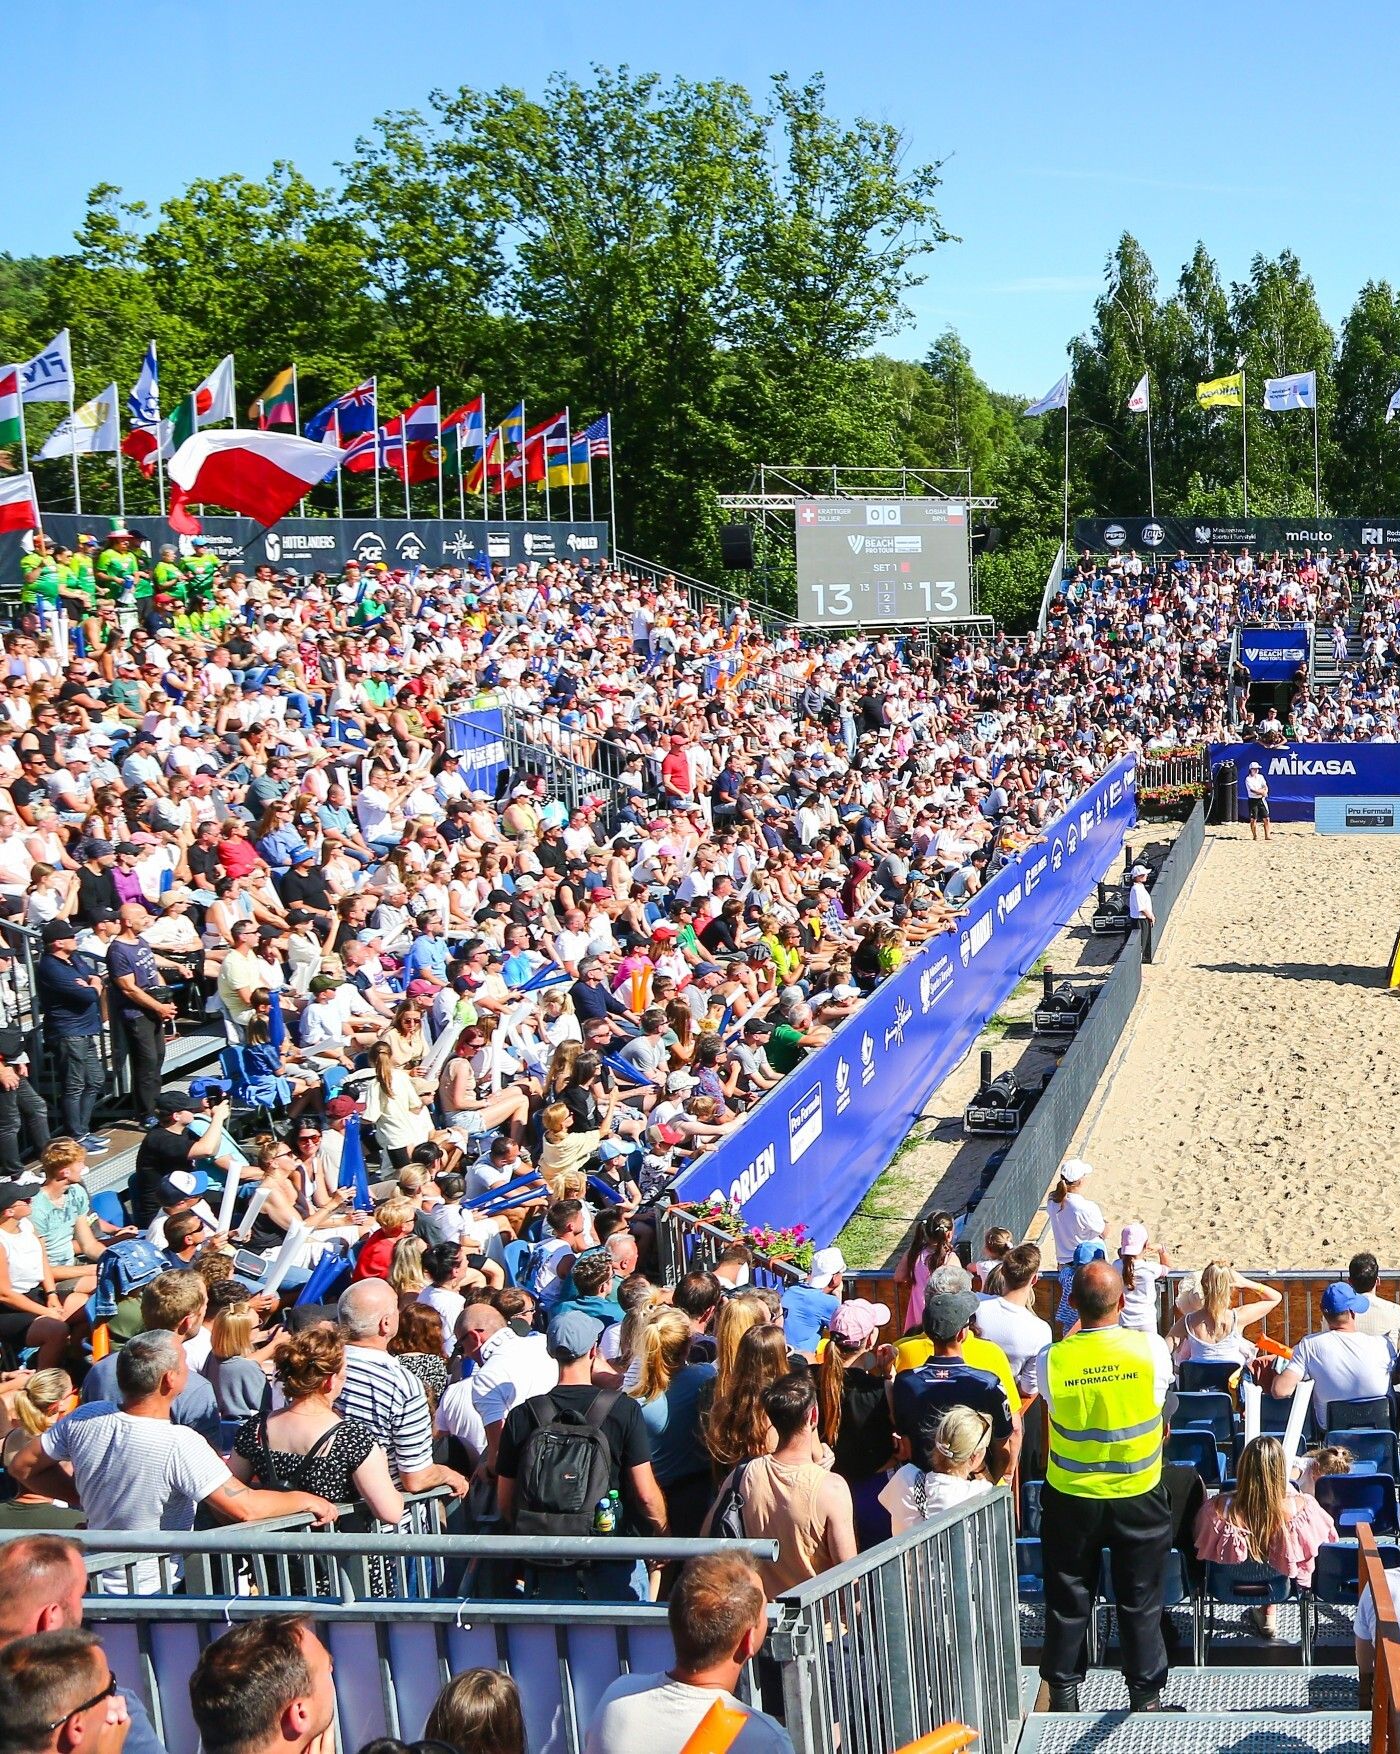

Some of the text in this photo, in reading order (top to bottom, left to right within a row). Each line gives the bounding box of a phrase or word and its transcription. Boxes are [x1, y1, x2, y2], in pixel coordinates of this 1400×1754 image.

[871, 509, 897, 521] 0 0
[1286, 530, 1333, 542] mAuto
[865, 538, 893, 547] BEACH
[358, 546, 382, 561] PGE
[873, 563, 891, 572] SET
[859, 583, 870, 591] 13
[903, 582, 913, 591] 13
[811, 583, 853, 615] 13
[883, 594, 890, 602] 2
[919, 581, 958, 612] 13
[883, 605, 890, 613] 3
[1348, 807, 1392, 815] Pro Formula
[729, 1142, 776, 1215] ORLEN
[1083, 1364, 1120, 1375] SŁUŻBY
[1064, 1371, 1139, 1387] INFORMACYJNE
